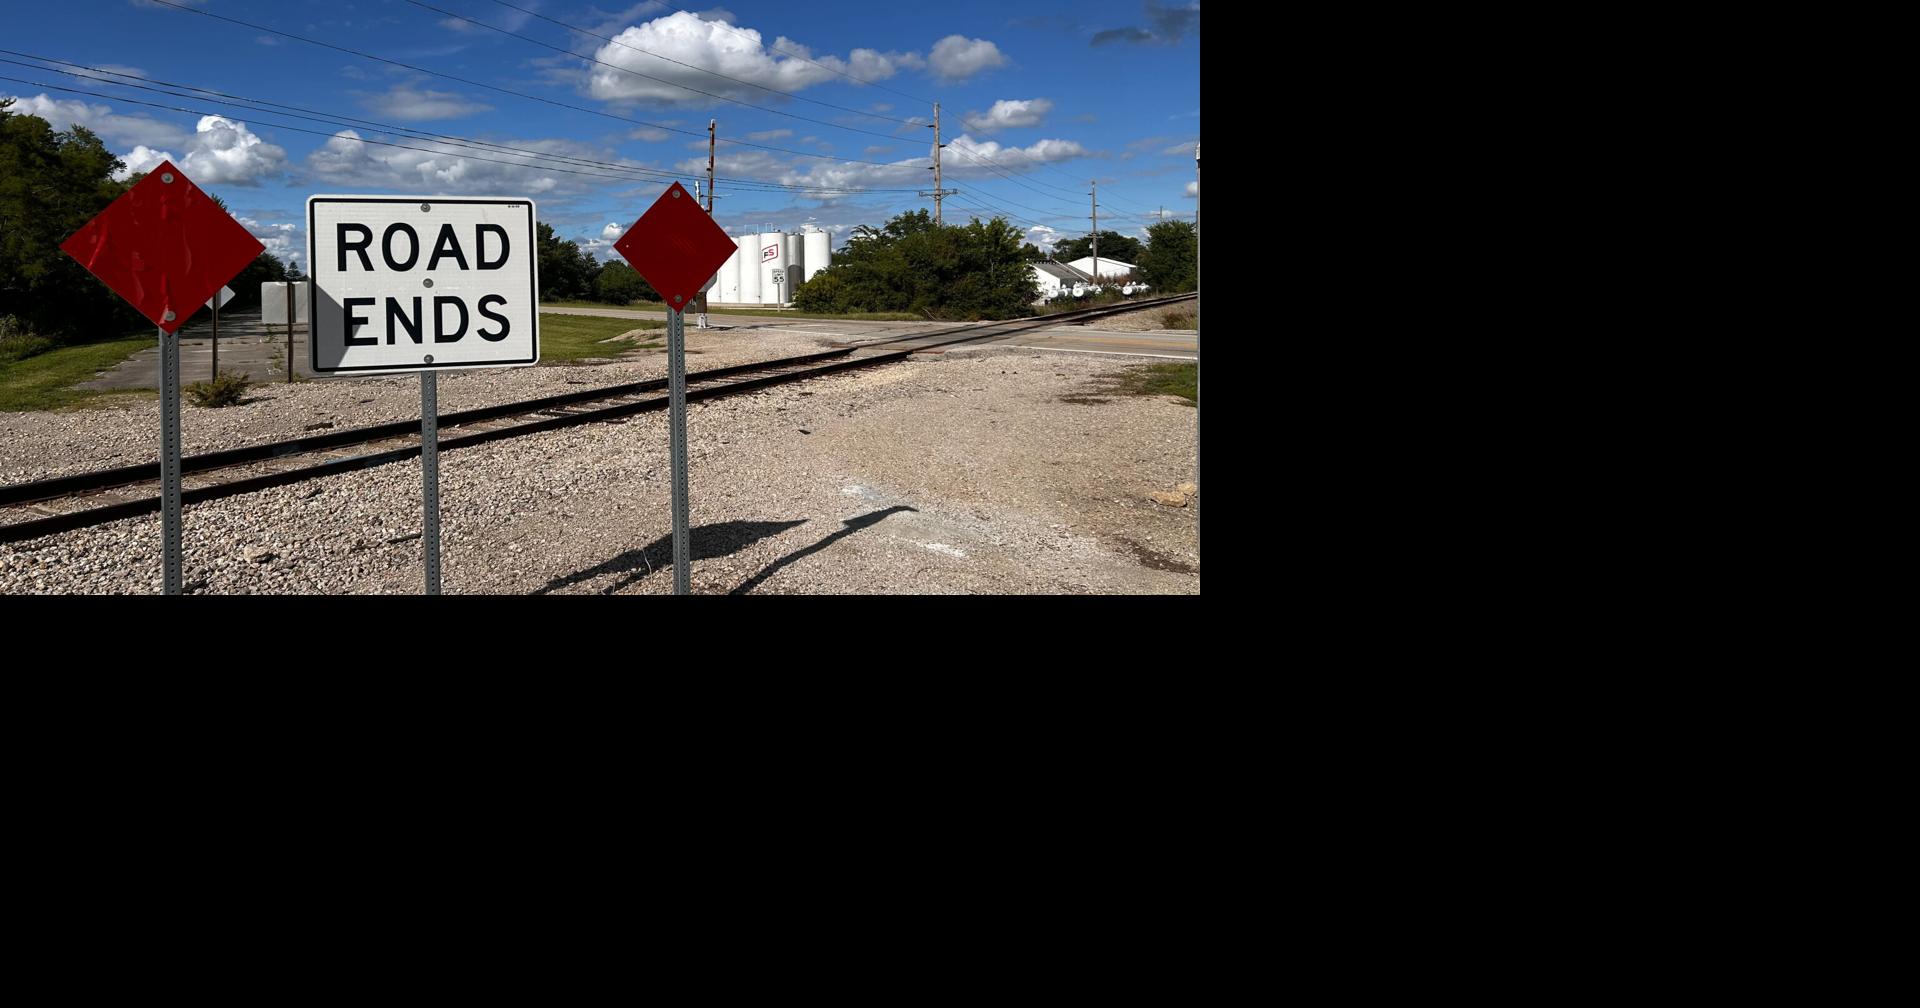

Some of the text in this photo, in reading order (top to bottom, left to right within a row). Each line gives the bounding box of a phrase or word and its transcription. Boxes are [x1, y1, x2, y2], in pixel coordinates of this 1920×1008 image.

[337, 223, 510, 271] ROAD
[764, 249, 774, 258] FS
[344, 294, 511, 347] ENDS
